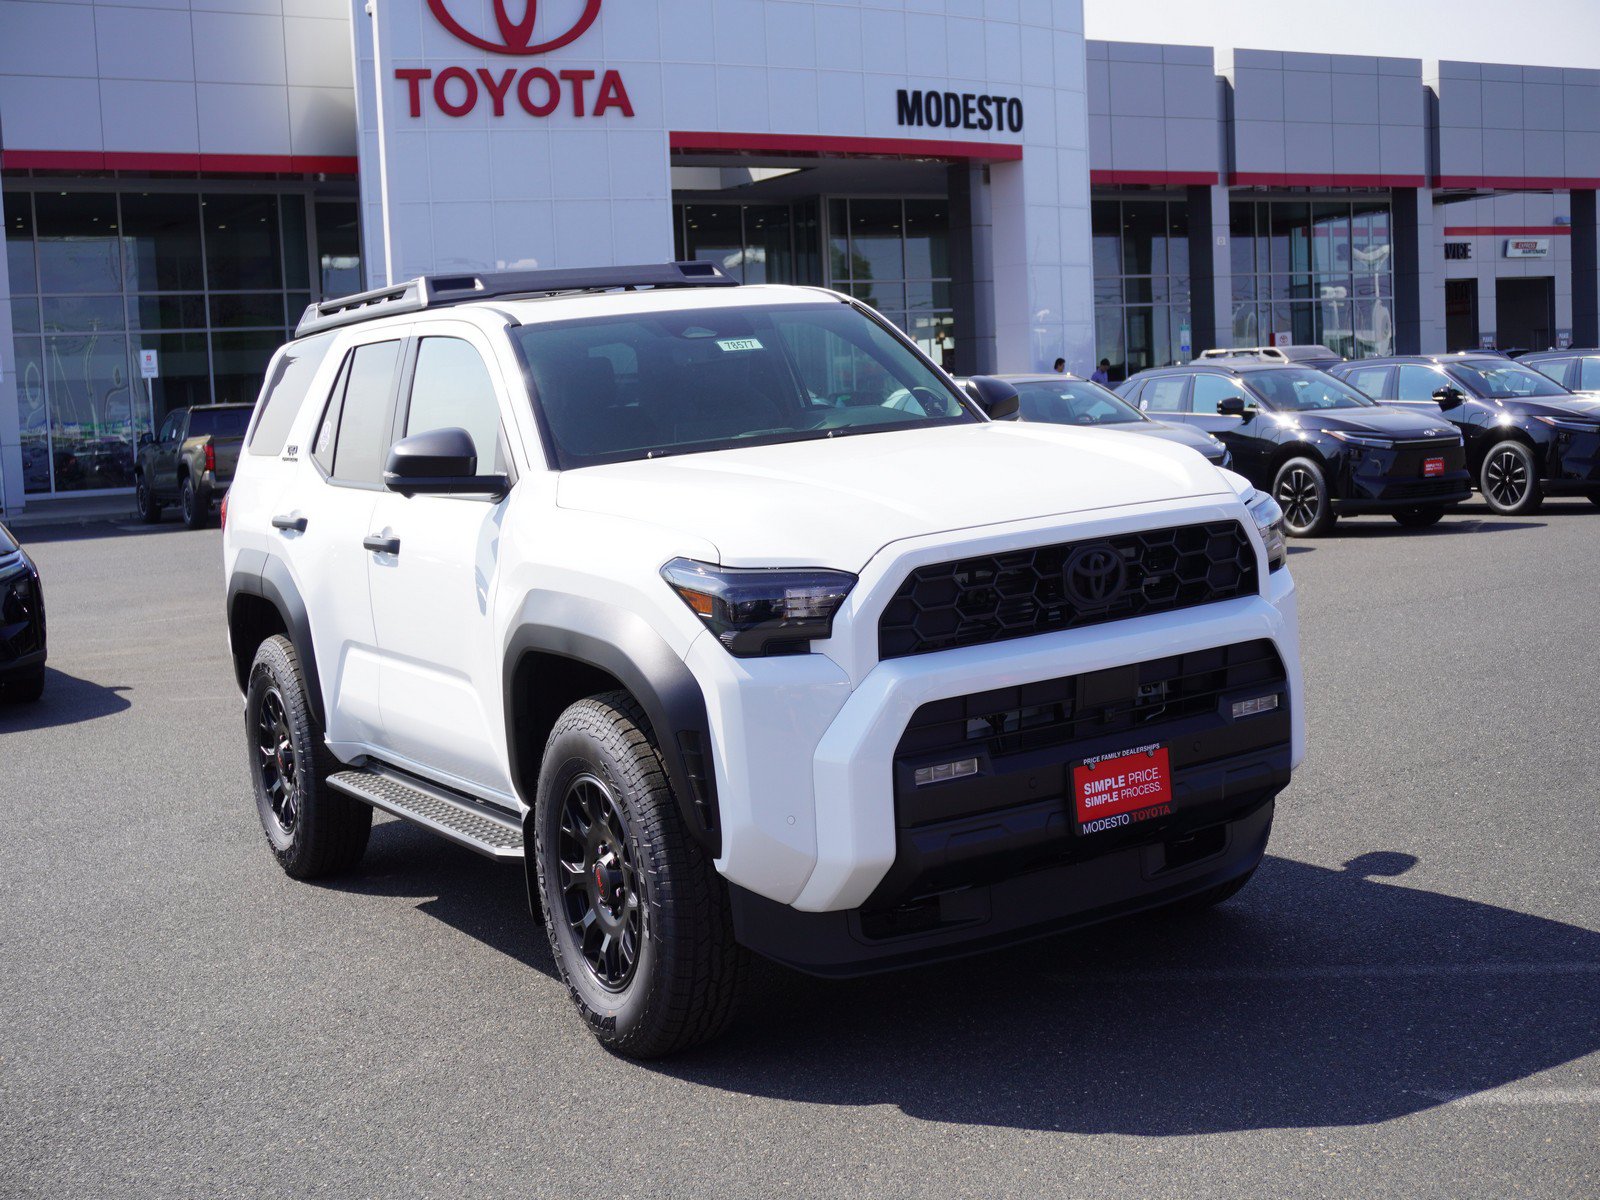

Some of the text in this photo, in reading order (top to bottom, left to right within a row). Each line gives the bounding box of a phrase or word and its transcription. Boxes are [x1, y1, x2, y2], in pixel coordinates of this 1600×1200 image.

[395, 66, 635, 118] TOYOTA
[897, 89, 1023, 133] MODESTO
[724, 340, 754, 350] 78577
[1083, 743, 1160, 765] PRICE FAMILY DEALERSHIPS
[1084, 767, 1161, 795] SIMPLE PRICE.
[1085, 782, 1162, 808] SIMPLE PROCESS.
[1083, 805, 1171, 835] MODESTO TOYOTA
